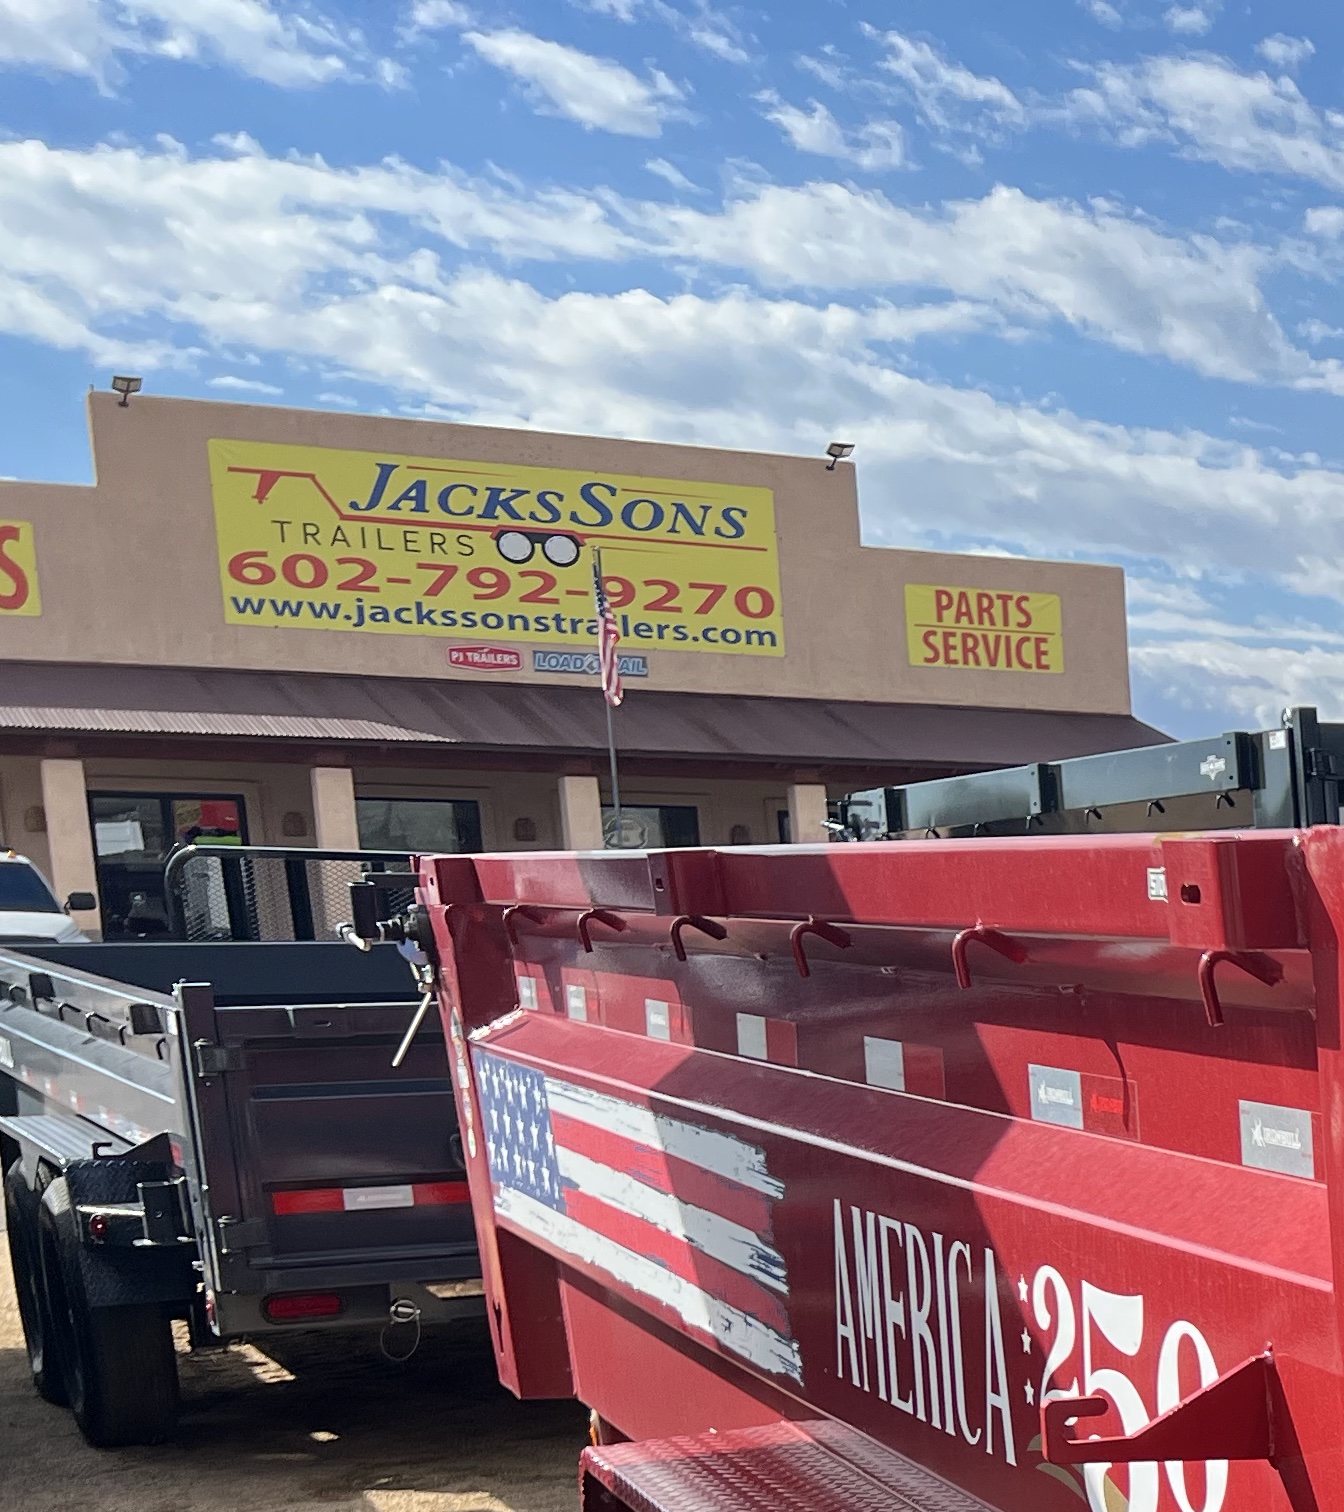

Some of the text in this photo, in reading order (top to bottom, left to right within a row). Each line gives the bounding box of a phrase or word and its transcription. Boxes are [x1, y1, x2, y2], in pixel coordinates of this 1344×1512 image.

[271, 520, 475, 556] TRAILERS
[228, 551, 775, 619] 602-792-9270
[231, 596, 778, 647] www.jackssonstralers.com
[935, 589, 1032, 628] PARTS
[451, 651, 519, 665] PJ TRAILERS
[535, 653, 584, 671] LOAD
[922, 630, 1050, 670] SERVICE
[833, 1198, 1017, 1467] AMERICA
